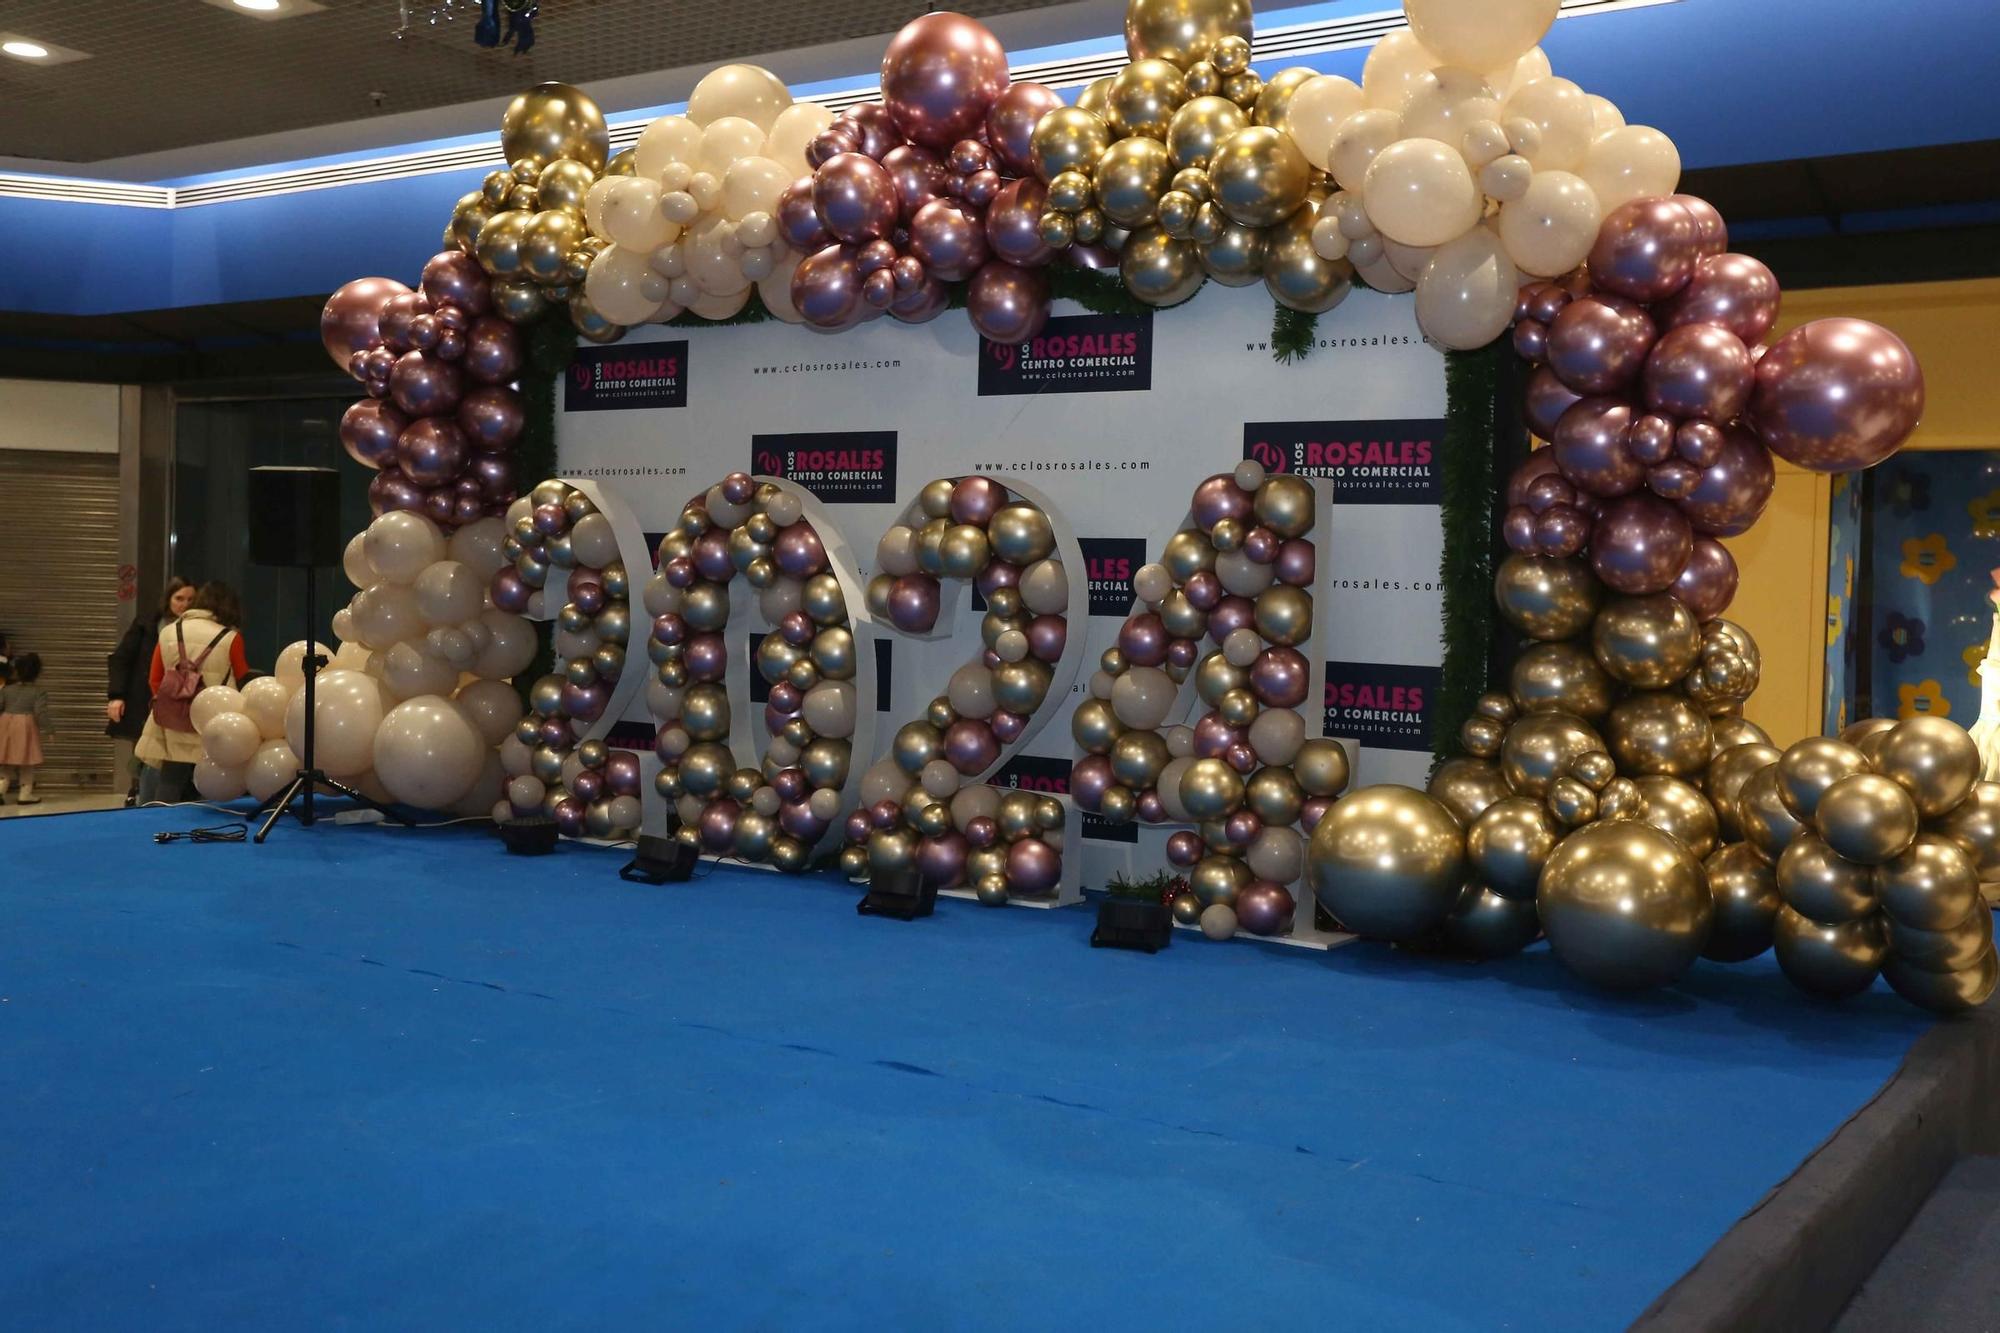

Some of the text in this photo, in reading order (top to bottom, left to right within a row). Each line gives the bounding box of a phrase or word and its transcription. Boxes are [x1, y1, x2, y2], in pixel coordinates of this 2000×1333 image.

[1032, 333, 1137, 358] ROSALES
[603, 357, 678, 379] ROSALES
[754, 359, 901, 375] www.cclosrosales.com
[1021, 356, 1136, 370] CENTRO COMERCIAL
[1022, 370, 1135, 380] www.cclosrosales.com
[595, 378, 676, 390] CENTRO COMERCIAL
[596, 389, 676, 398] www.cclosrosales.com
[787, 451, 795, 470] LOS
[796, 449, 885, 471] ROSALES
[1294, 442, 1304, 465] LOS
[1306, 441, 1433, 466] ROSALES
[562, 466, 686, 476] www.cclosrosales.com
[975, 460, 1150, 472] www.cclosrosales.com
[1294, 466, 1431, 477] CENTRO COMERCIAL
[787, 471, 883, 481] CENTRO COMERCIAL
[1332, 480, 1430, 489] losrosales.com
[1088, 581, 1129, 591] ERCIAL
[1333, 578, 1446, 592] rosales.com
[1325, 682, 1424, 711] OSALES
[490, 460, 1358, 948] 2024
[1344, 708, 1422, 723] COMERCIAL
